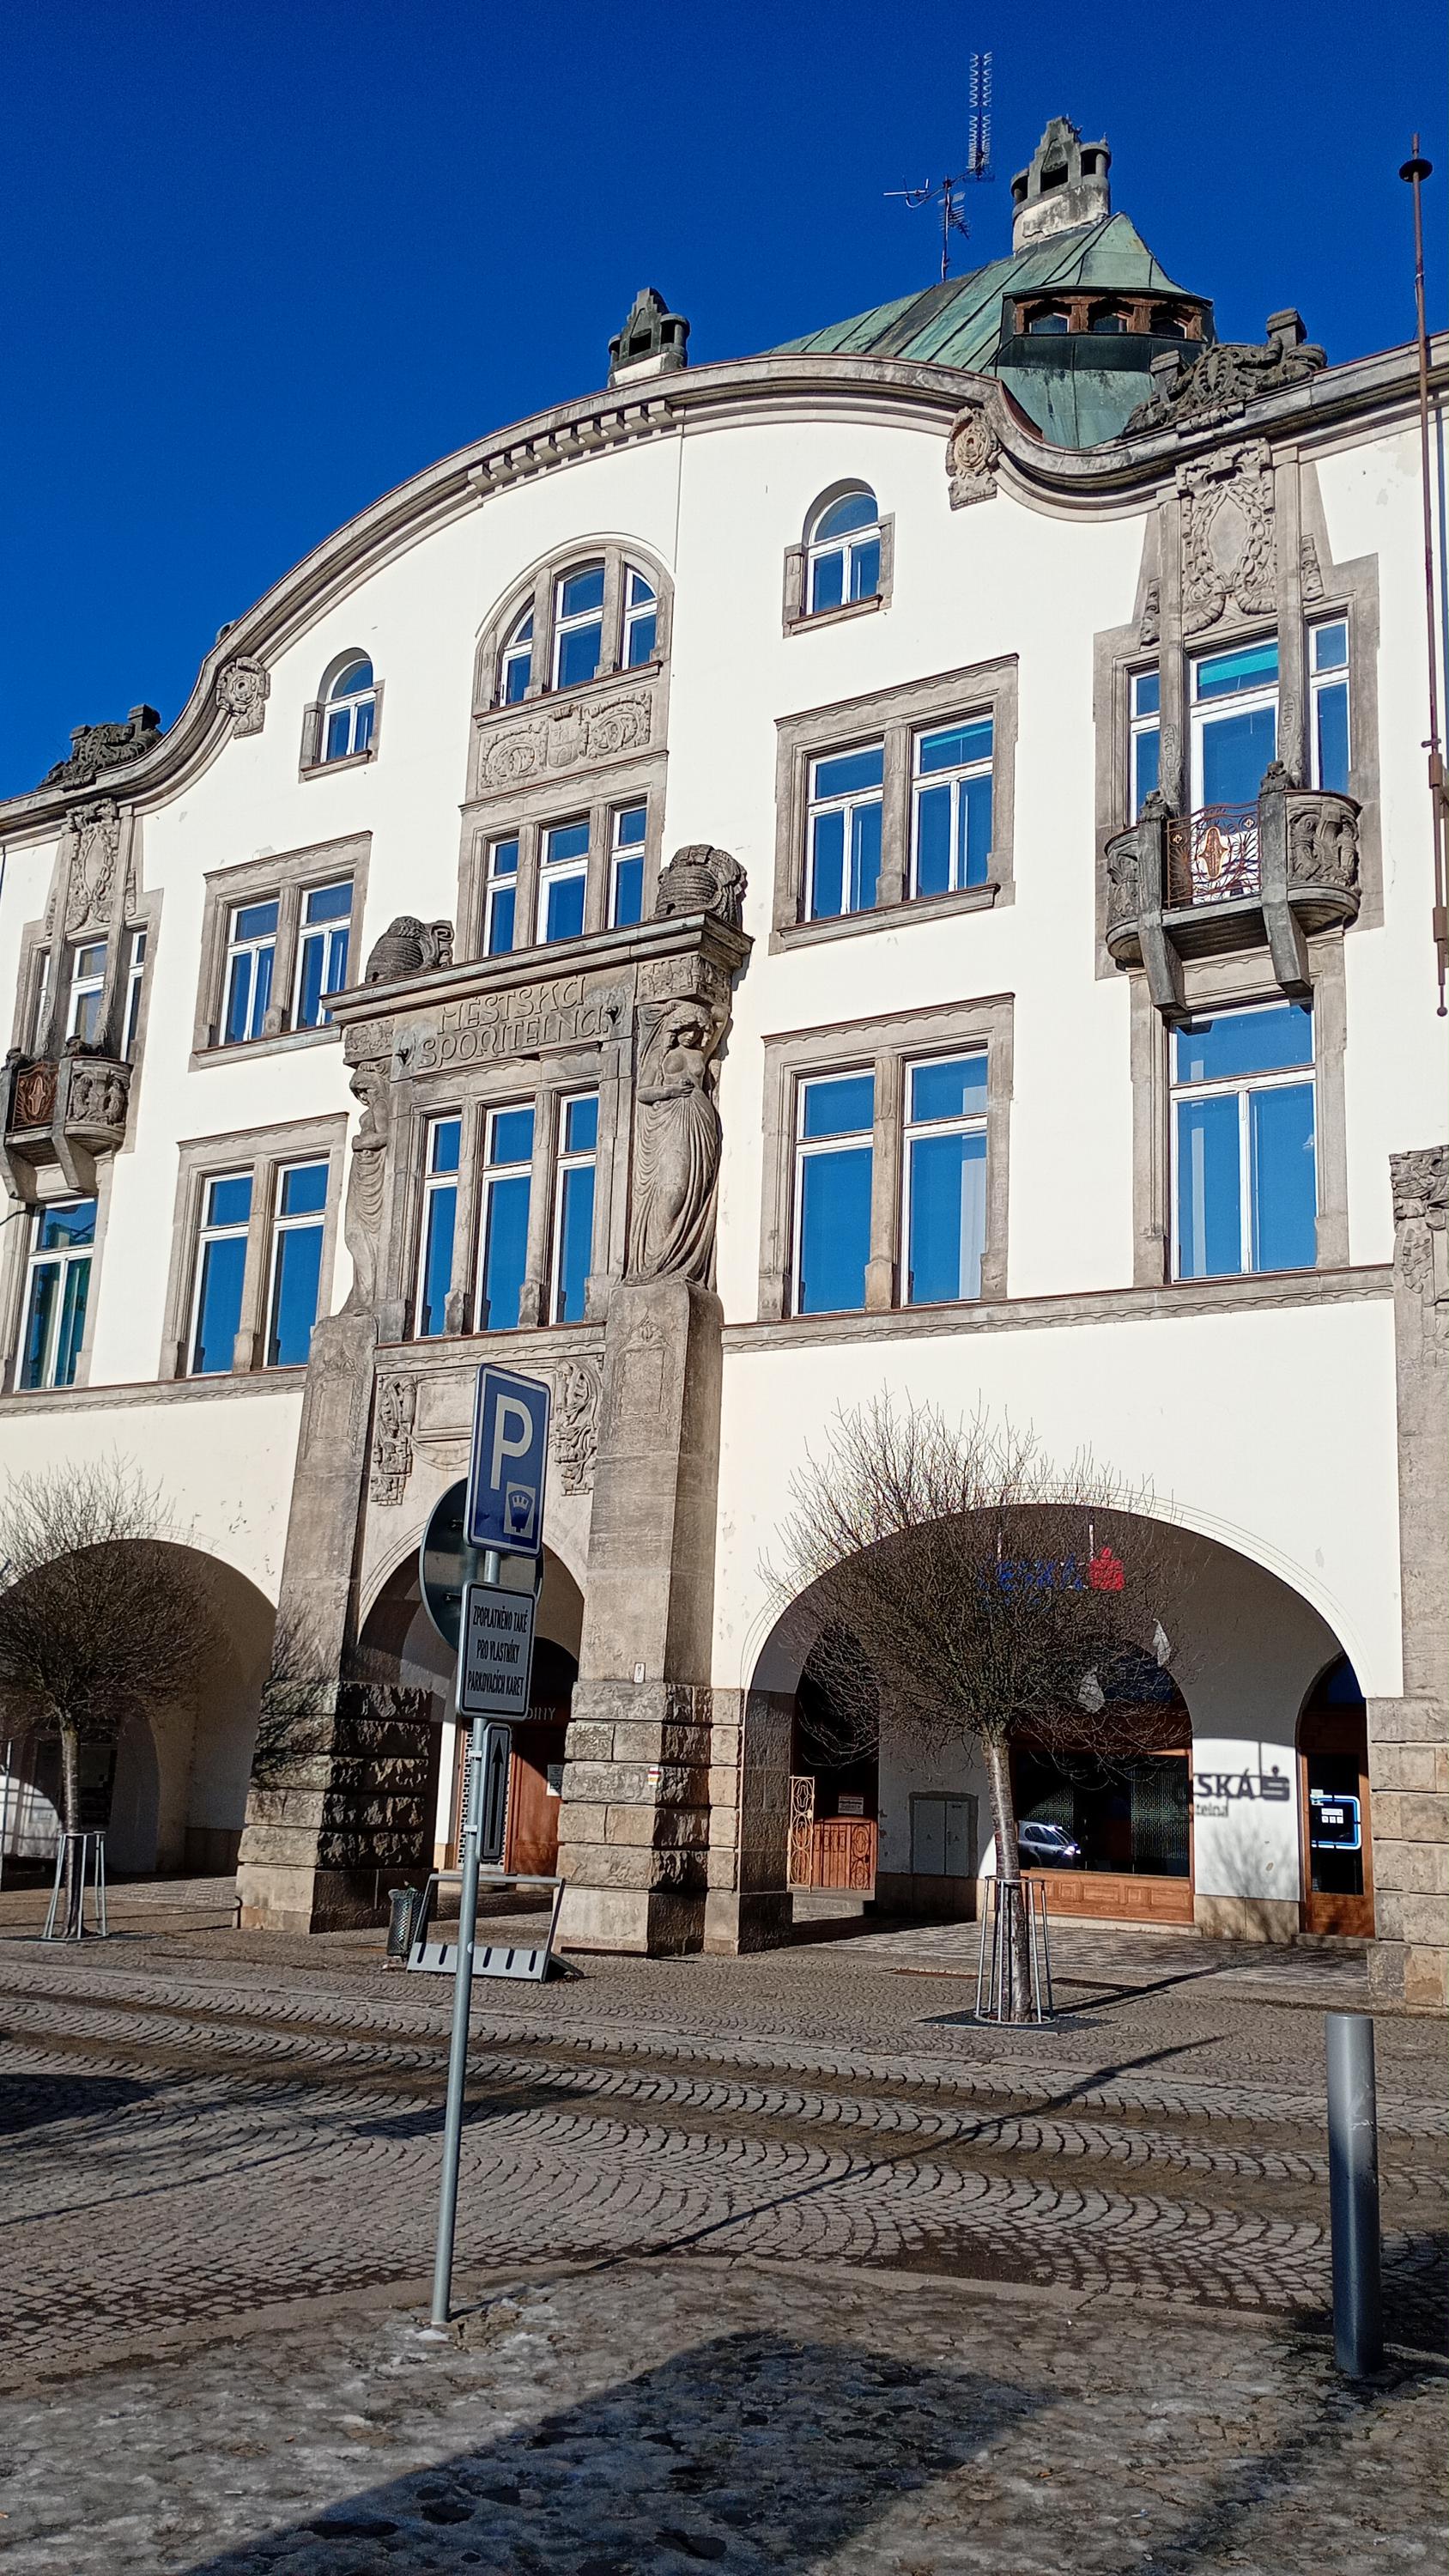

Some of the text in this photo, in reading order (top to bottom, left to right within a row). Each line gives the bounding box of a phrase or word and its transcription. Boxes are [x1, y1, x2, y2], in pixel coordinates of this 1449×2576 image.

[437, 975, 585, 1035] MĚSTSKÁ
[418, 1005, 608, 1068] SPOŘITELNA
[490, 1393, 533, 1490] P
[473, 1605, 528, 1633] ZPOPLATNĚNO TAKÉ
[476, 1639, 488, 1660] PRO
[506, 1675, 524, 1697] KARET
